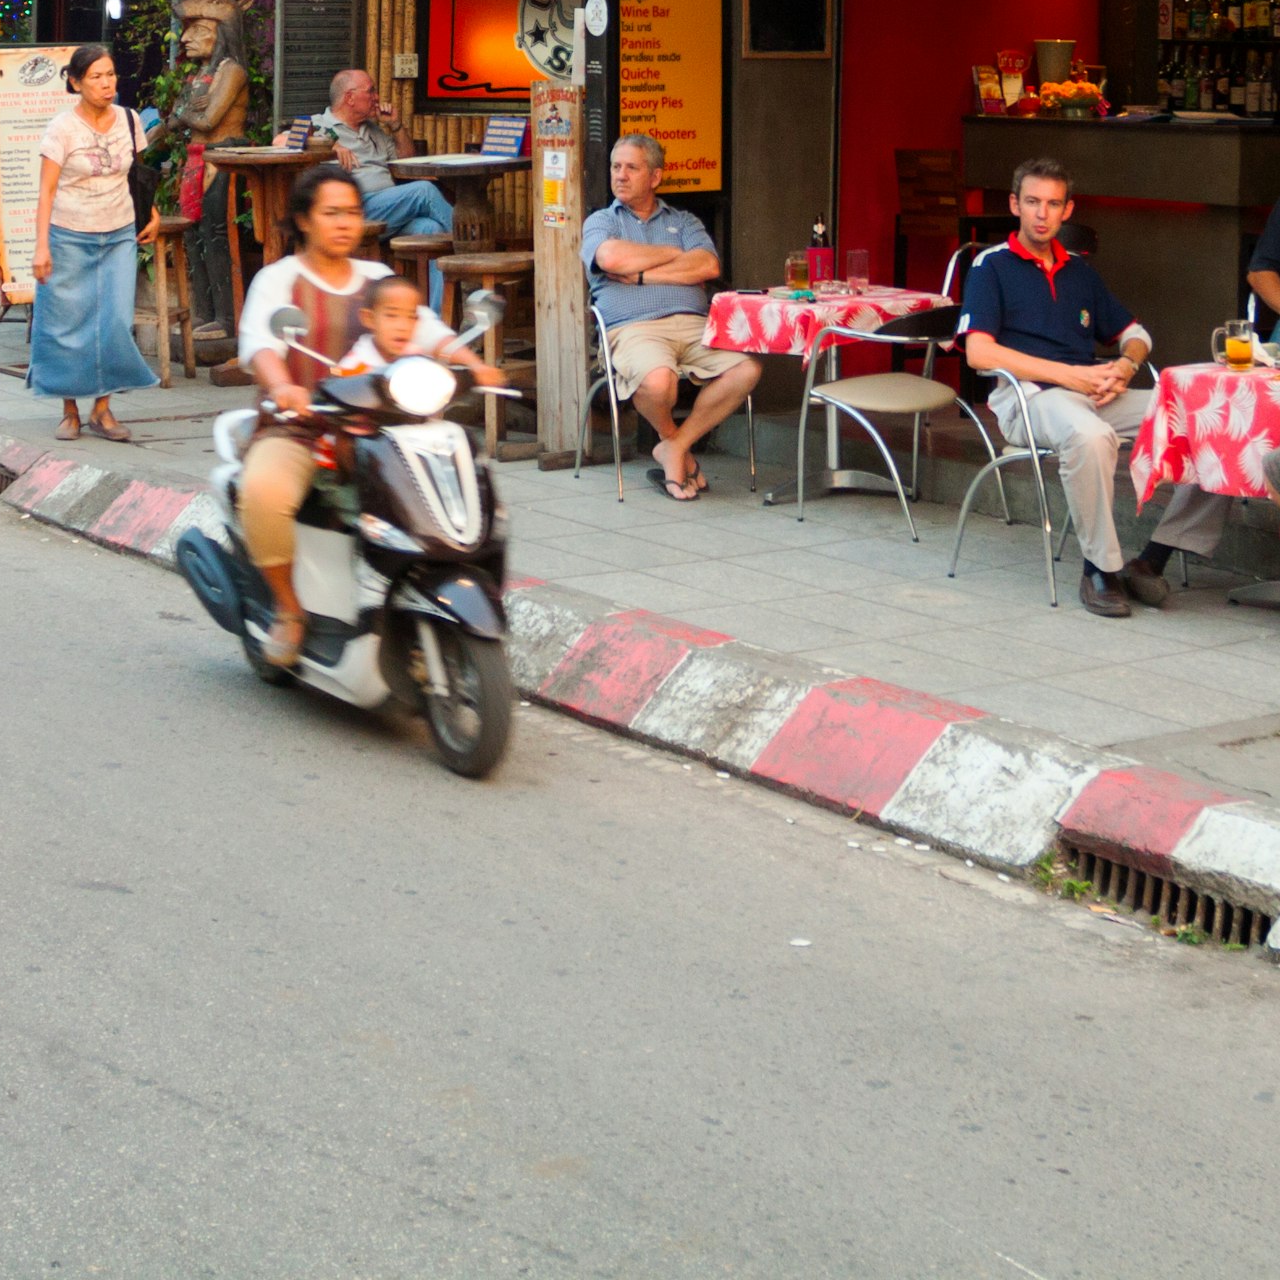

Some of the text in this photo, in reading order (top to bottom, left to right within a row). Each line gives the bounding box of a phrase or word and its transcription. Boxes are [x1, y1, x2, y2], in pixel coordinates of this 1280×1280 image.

[621, 6, 670, 17] Wine Bar
[621, 38, 661, 49] Paninis
[621, 68, 660, 80] Quiche
[621, 97, 683, 111] Savory Pies
[649, 128, 696, 140] Shooters
[662, 157, 717, 171] eas+Coffee
